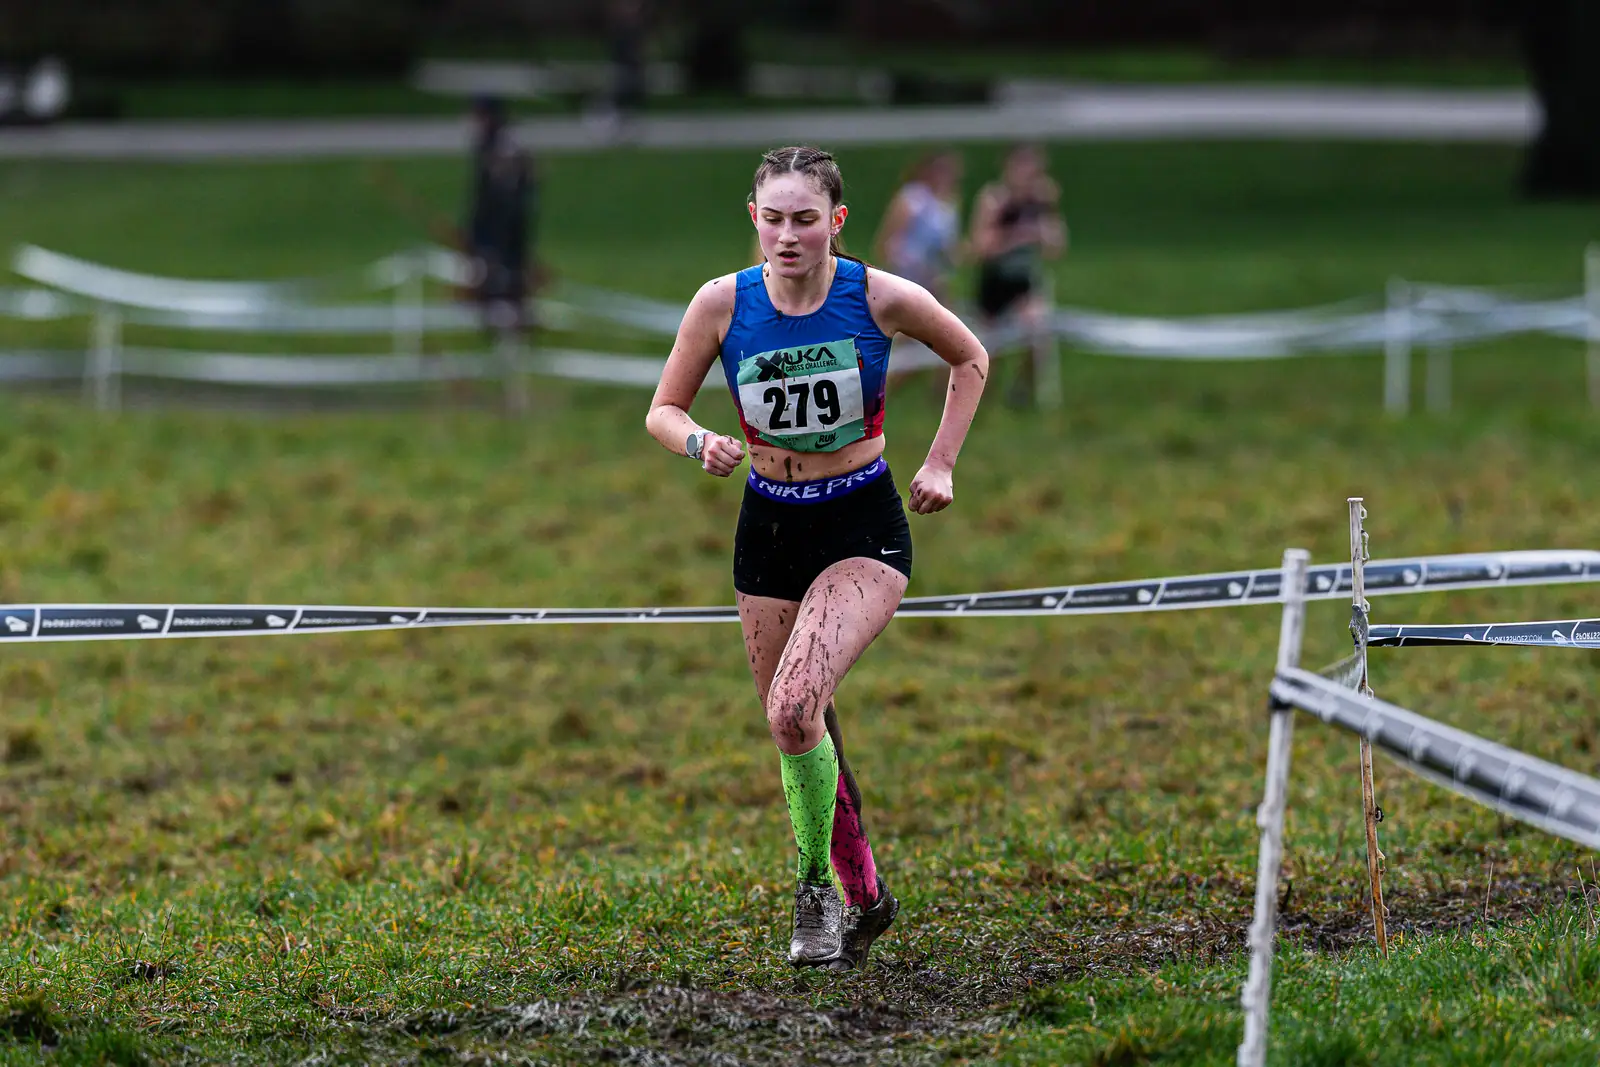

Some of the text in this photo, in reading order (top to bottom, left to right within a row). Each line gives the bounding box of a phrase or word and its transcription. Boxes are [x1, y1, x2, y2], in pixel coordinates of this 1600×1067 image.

[785, 358, 838, 372] CROSS CHALLENGE
[763, 379, 841, 430] 279
[818, 432, 837, 443] RUN
[758, 480, 823, 499] NIKE
